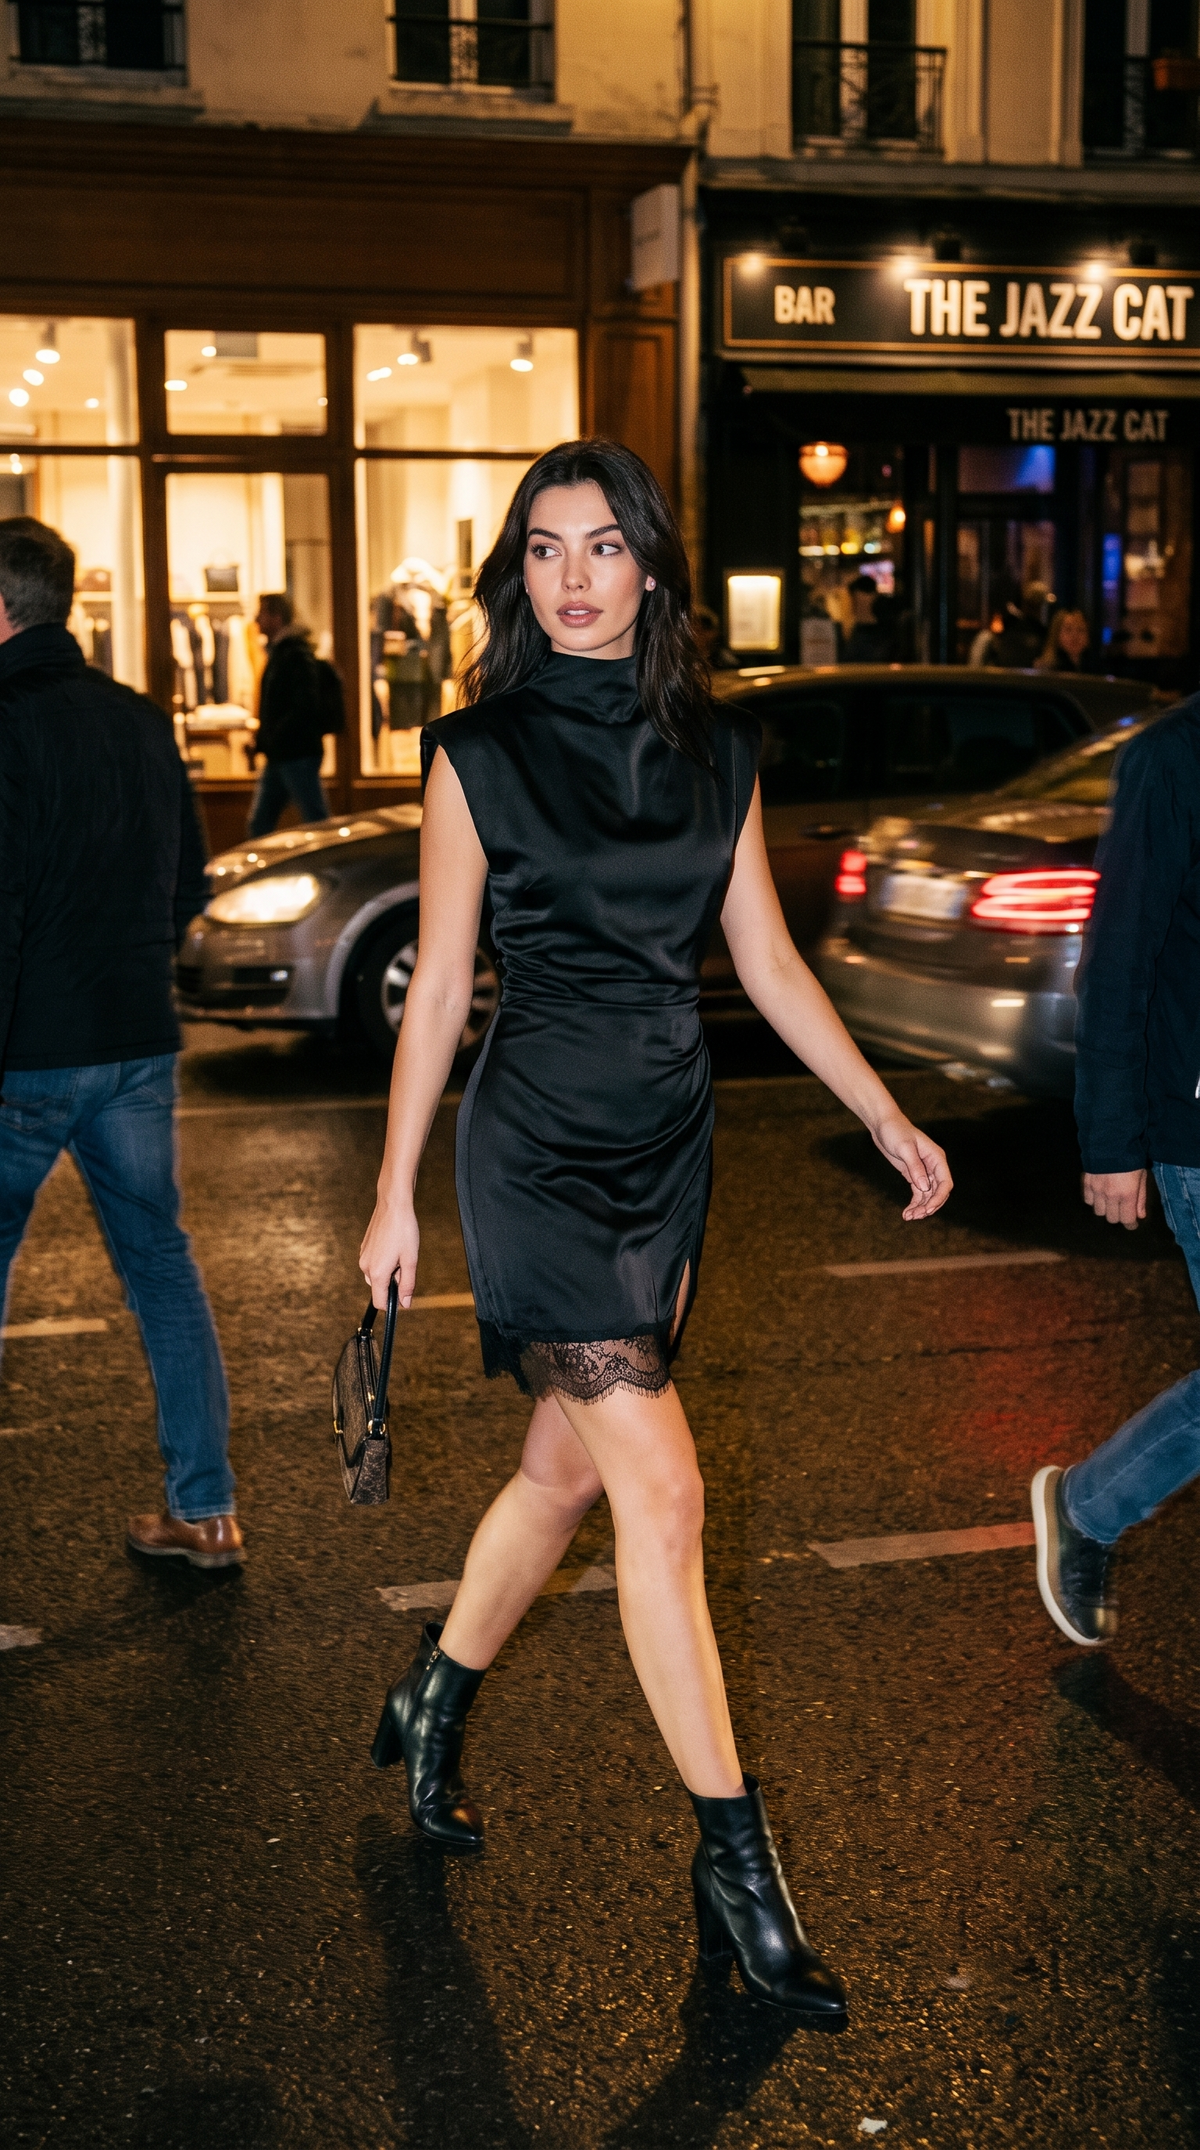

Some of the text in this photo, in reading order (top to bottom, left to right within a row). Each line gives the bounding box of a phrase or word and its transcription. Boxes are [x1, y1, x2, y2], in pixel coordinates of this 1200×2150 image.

[774, 285, 836, 325] BAR
[904, 279, 1194, 341] THE JAZZ CAT
[1007, 408, 1169, 442] THE JAZZ CAT
